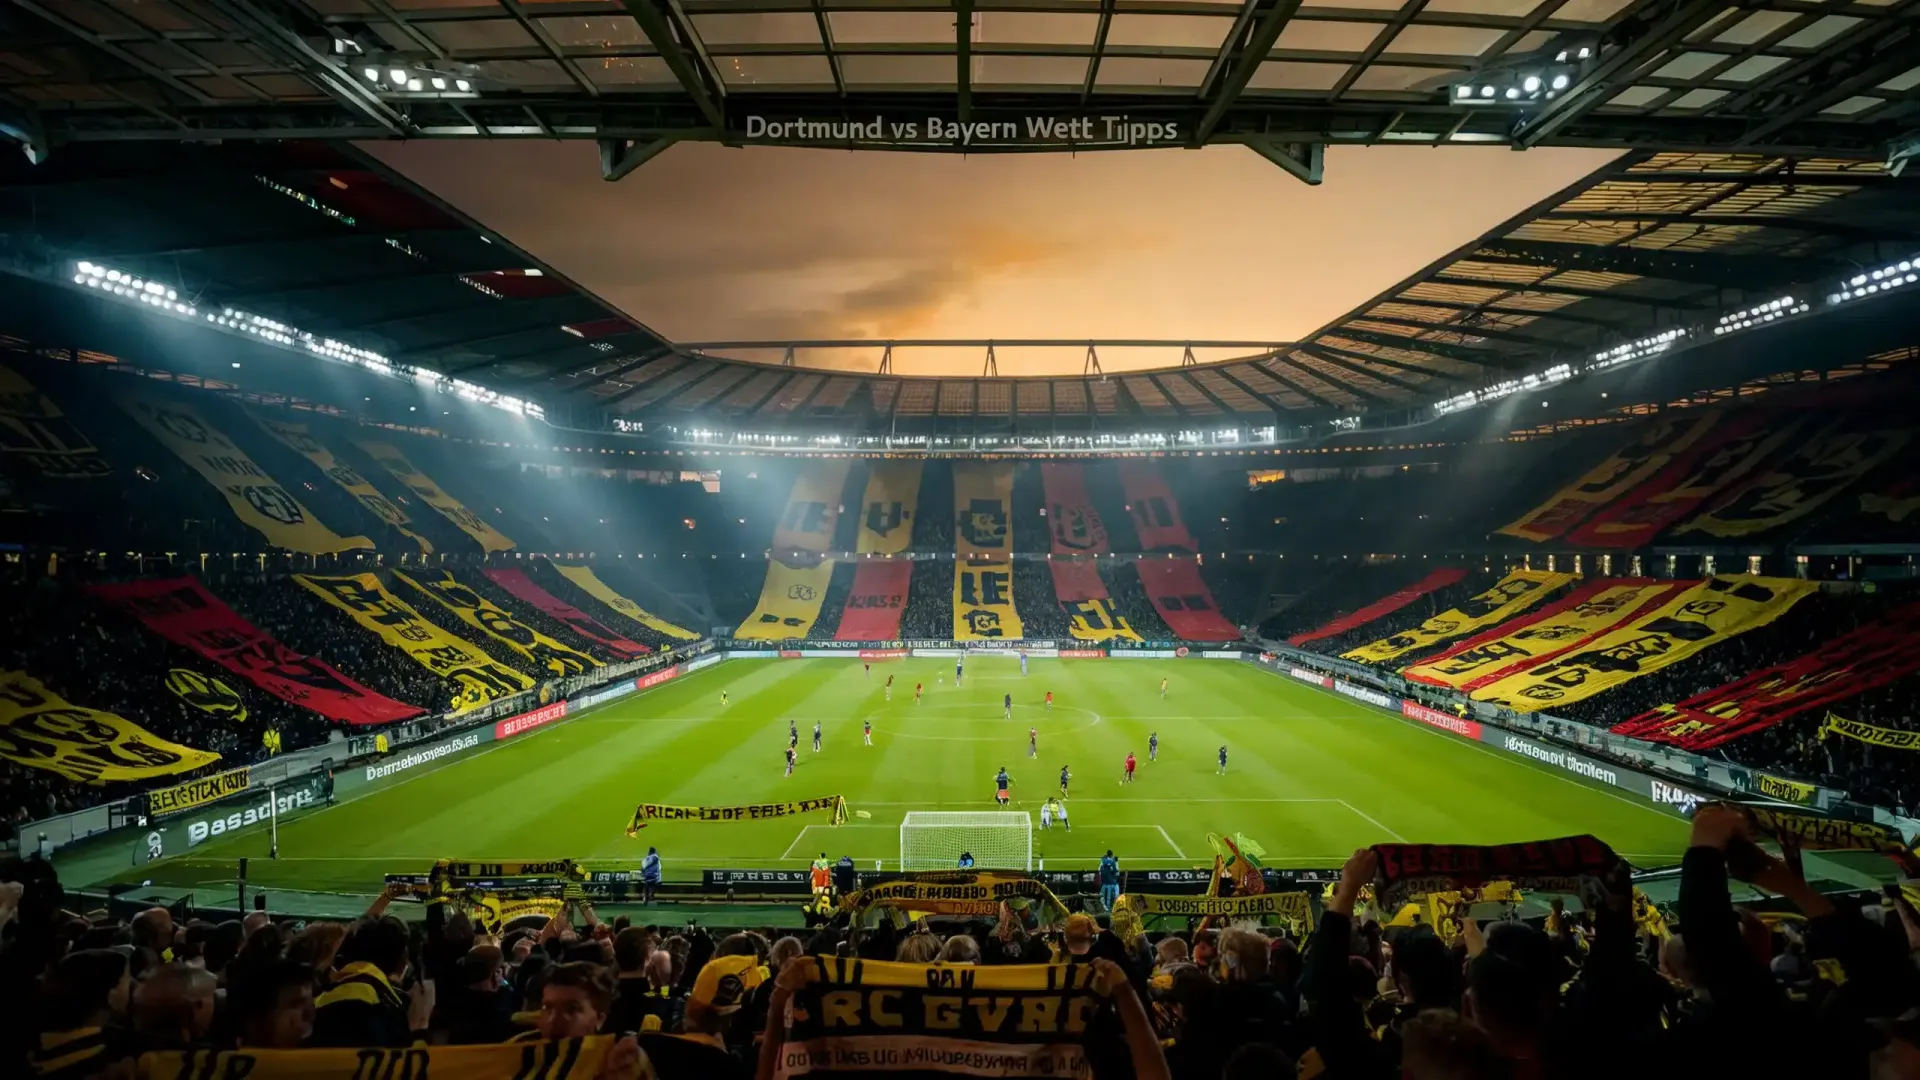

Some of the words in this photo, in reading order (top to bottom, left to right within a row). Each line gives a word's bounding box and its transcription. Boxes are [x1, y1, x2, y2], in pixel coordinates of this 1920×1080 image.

[746, 115, 883, 139] Dortmund
[890, 122, 918, 139] vs
[927, 117, 1017, 145] Bayern
[1025, 116, 1094, 139] Wett
